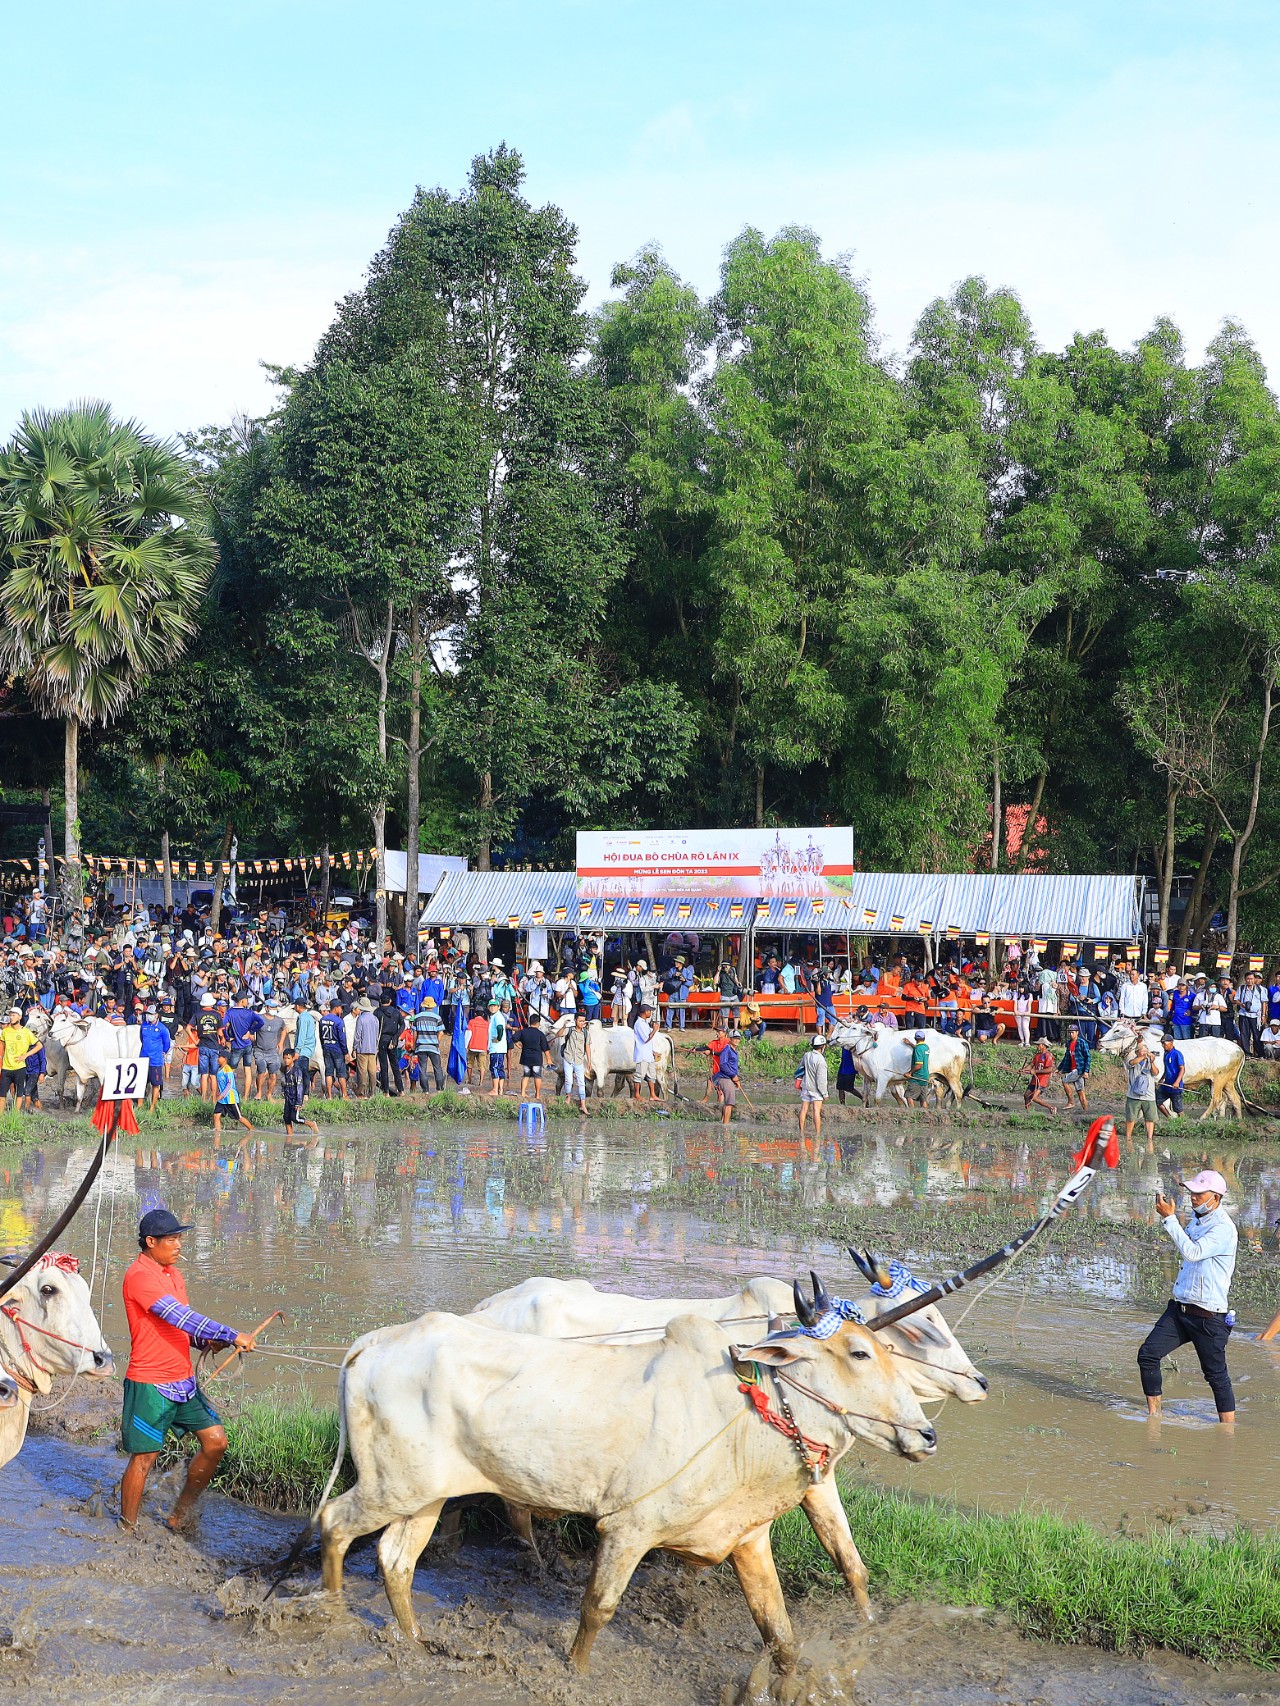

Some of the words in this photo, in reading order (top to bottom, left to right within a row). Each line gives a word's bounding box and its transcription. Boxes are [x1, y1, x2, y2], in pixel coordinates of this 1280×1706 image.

[603, 852, 621, 863] HỘI
[622, 853, 643, 861] ĐUA
[645, 851, 659, 861] BÒ
[661, 851, 689, 861] CHÙA
[729, 852, 740, 860] IX
[322, 1025, 333, 1039] 21
[112, 1062, 138, 1095] 12
